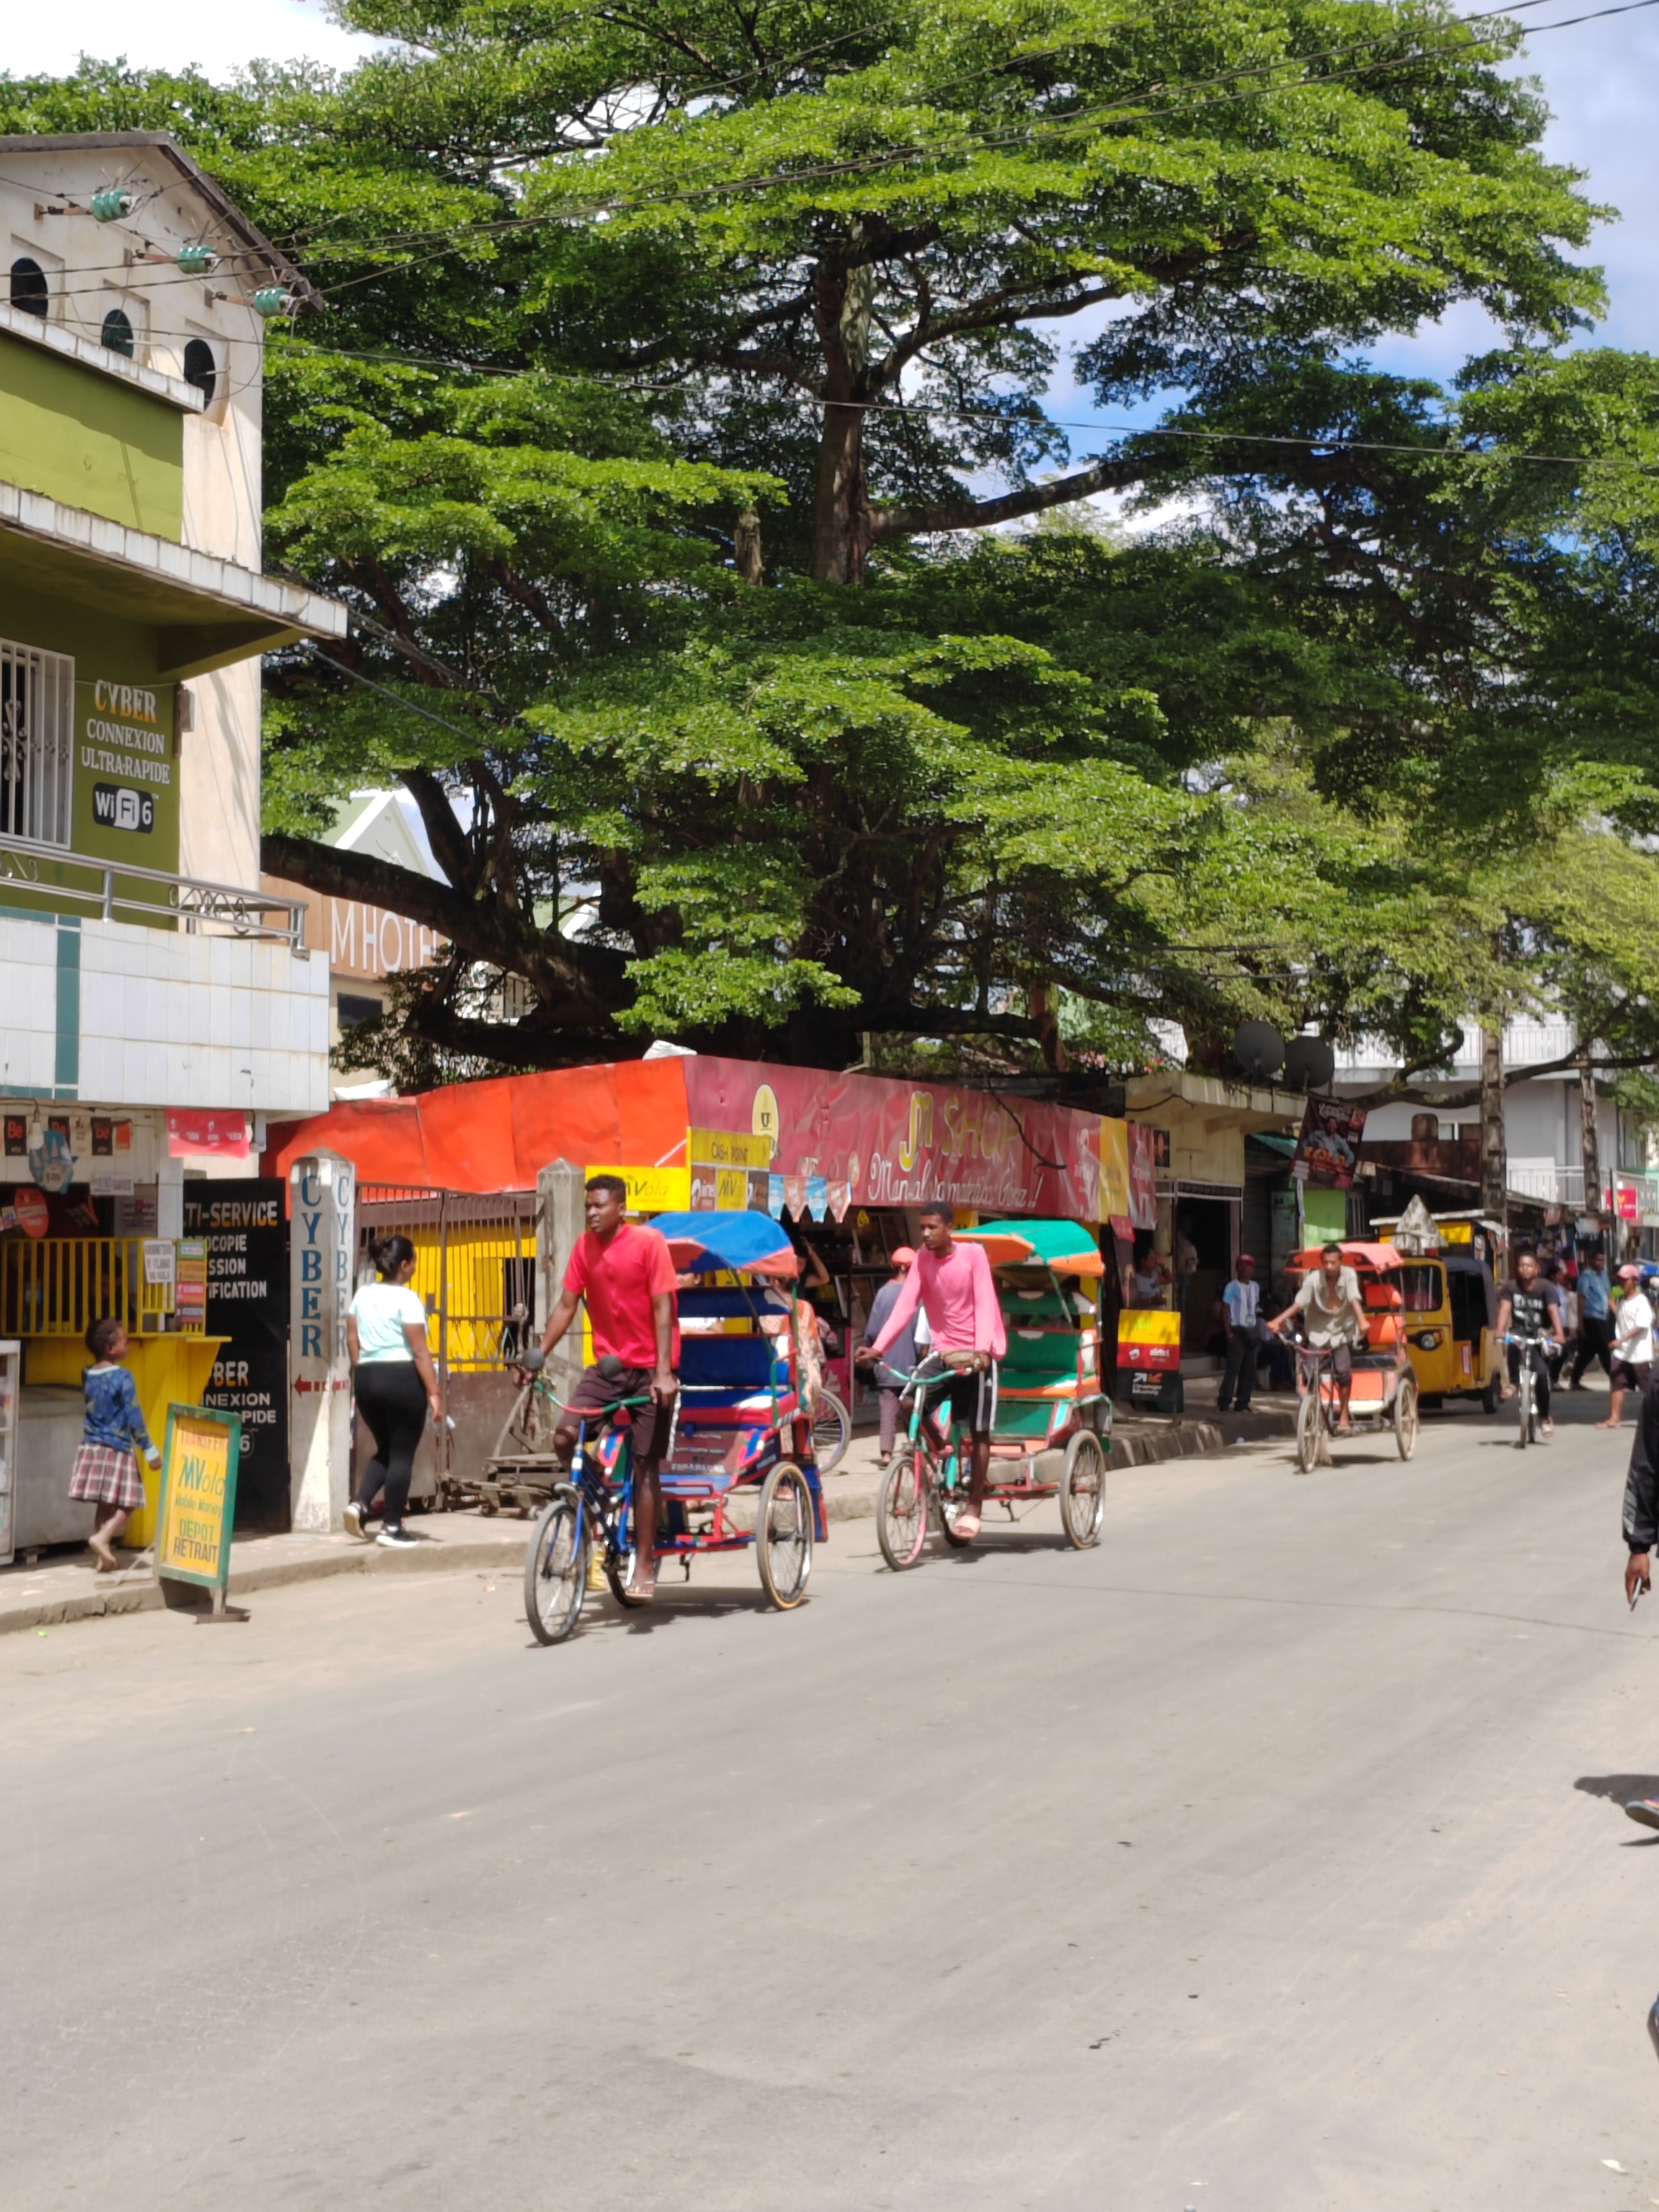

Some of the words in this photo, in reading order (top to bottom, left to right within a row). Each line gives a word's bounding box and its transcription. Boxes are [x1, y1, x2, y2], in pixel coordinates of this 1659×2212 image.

[95, 679, 157, 724] CYBER
[87, 718, 165, 754] CONNEXION
[8, 1120, 23, 1139] Be
[940, 1094, 1026, 1162] SHOP
[711, 1141, 729, 1161] CASH
[301, 1174, 322, 1357] CYBER
[335, 1175, 349, 1357] CYBER
[179, 1518, 215, 1543] DEPOT
[173, 1536, 219, 1564] RETRAIT
